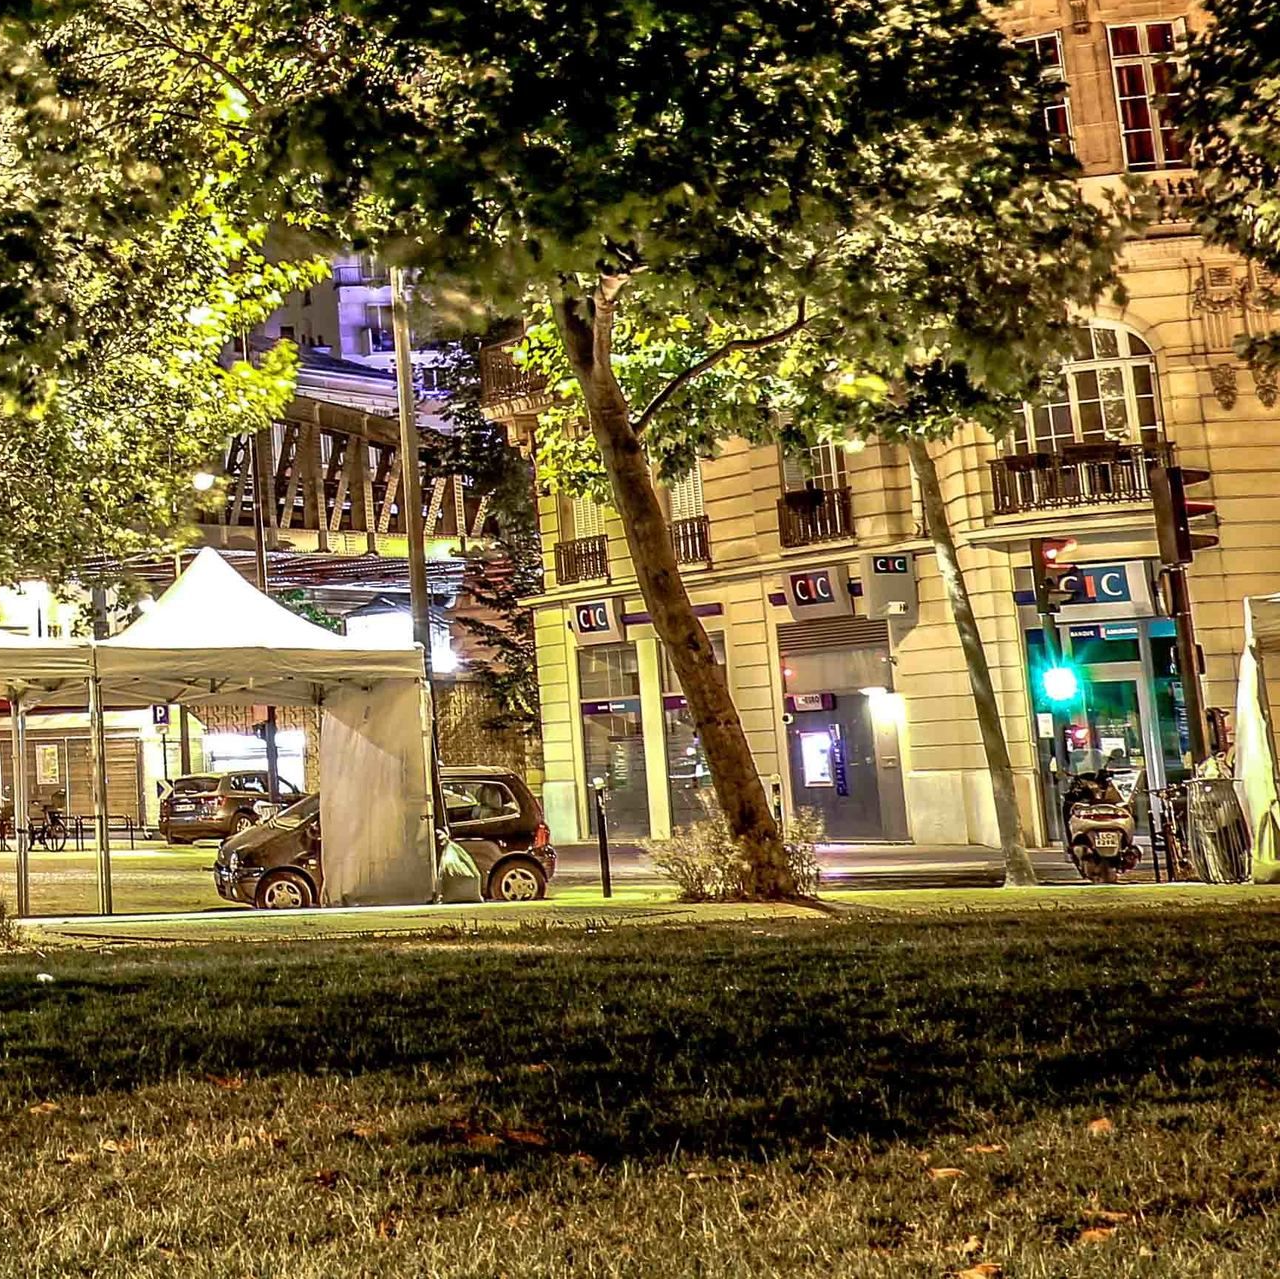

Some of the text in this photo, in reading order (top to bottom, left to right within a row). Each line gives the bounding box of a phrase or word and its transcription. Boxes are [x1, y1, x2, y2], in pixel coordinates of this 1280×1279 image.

[876, 558, 905, 571] CIC
[795, 577, 830, 600] CIC
[579, 607, 607, 628] CIC
[156, 706, 165, 721] P
